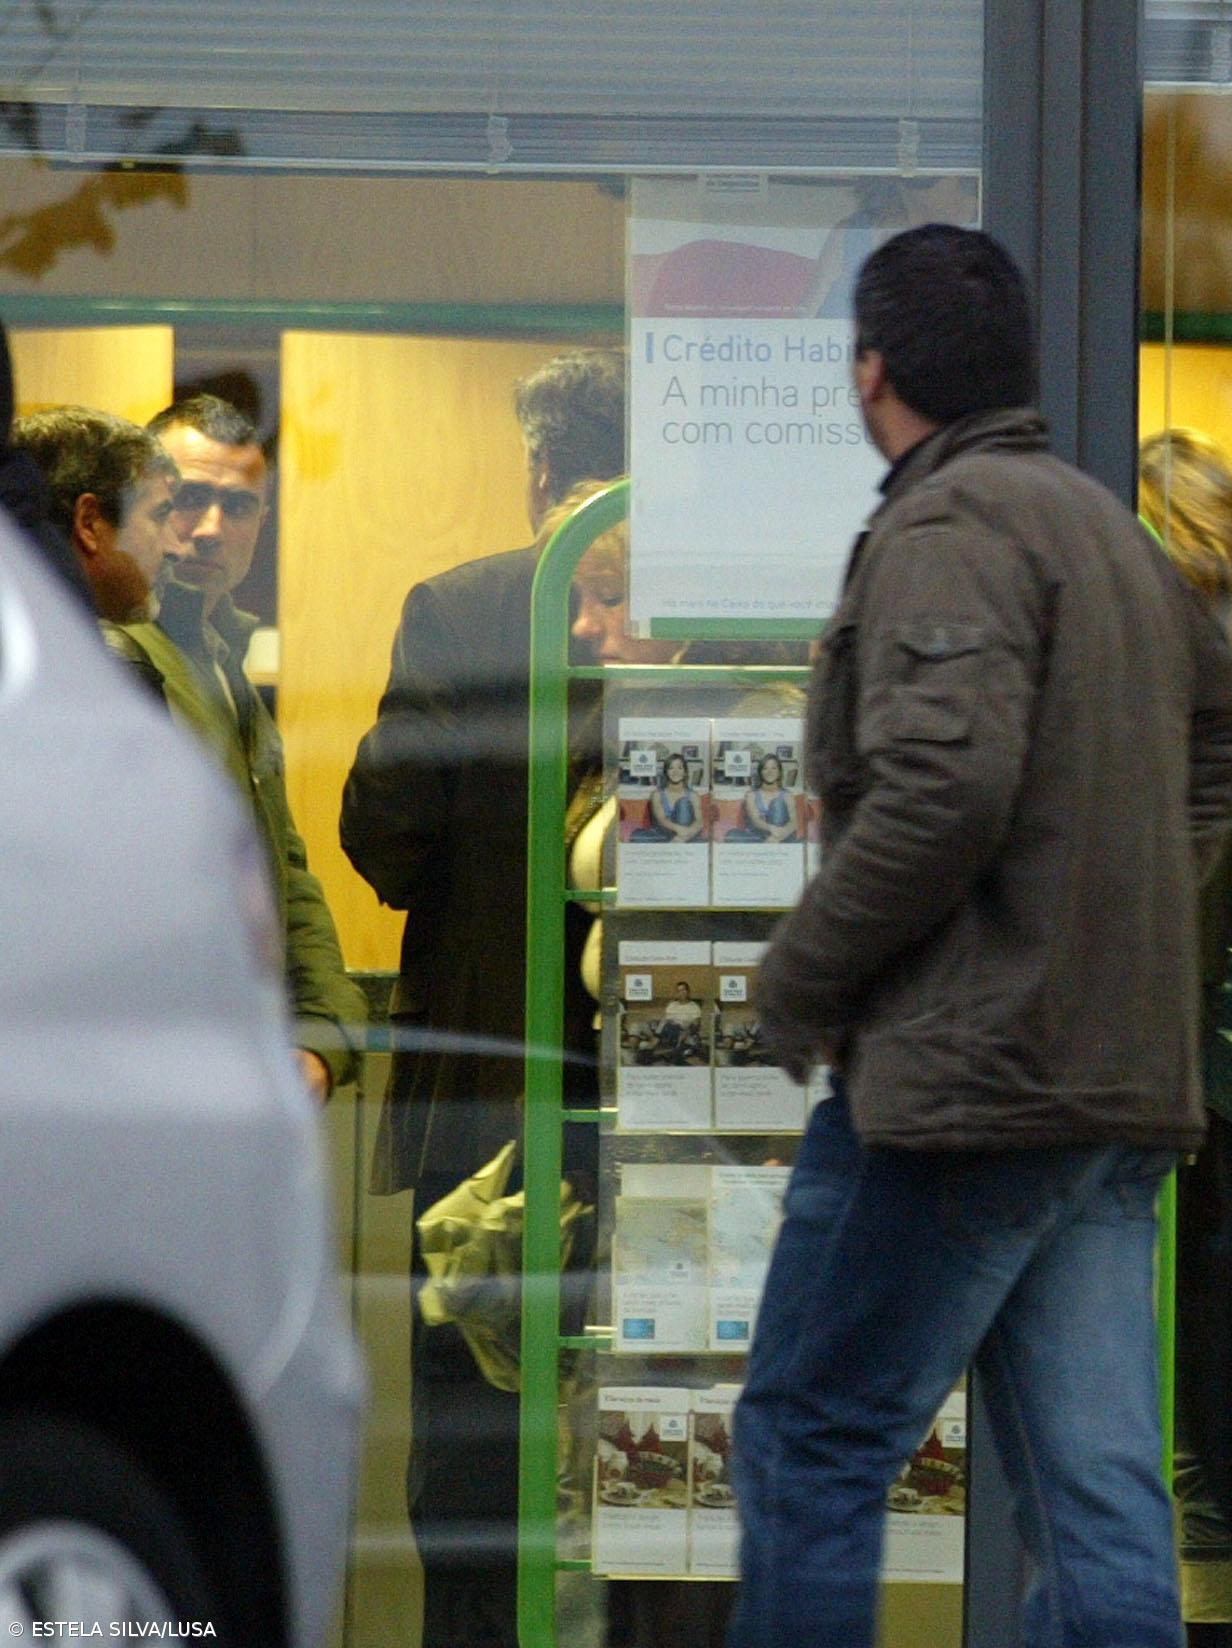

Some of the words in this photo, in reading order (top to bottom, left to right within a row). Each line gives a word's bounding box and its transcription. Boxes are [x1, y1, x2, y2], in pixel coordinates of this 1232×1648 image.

[663, 334, 772, 363] Crédito
[784, 335, 855, 363] Habi
[662, 377, 687, 408] A
[700, 376, 798, 408] minha
[812, 384, 862, 416] pre
[662, 420, 733, 445] com
[745, 414, 873, 445] comiss
